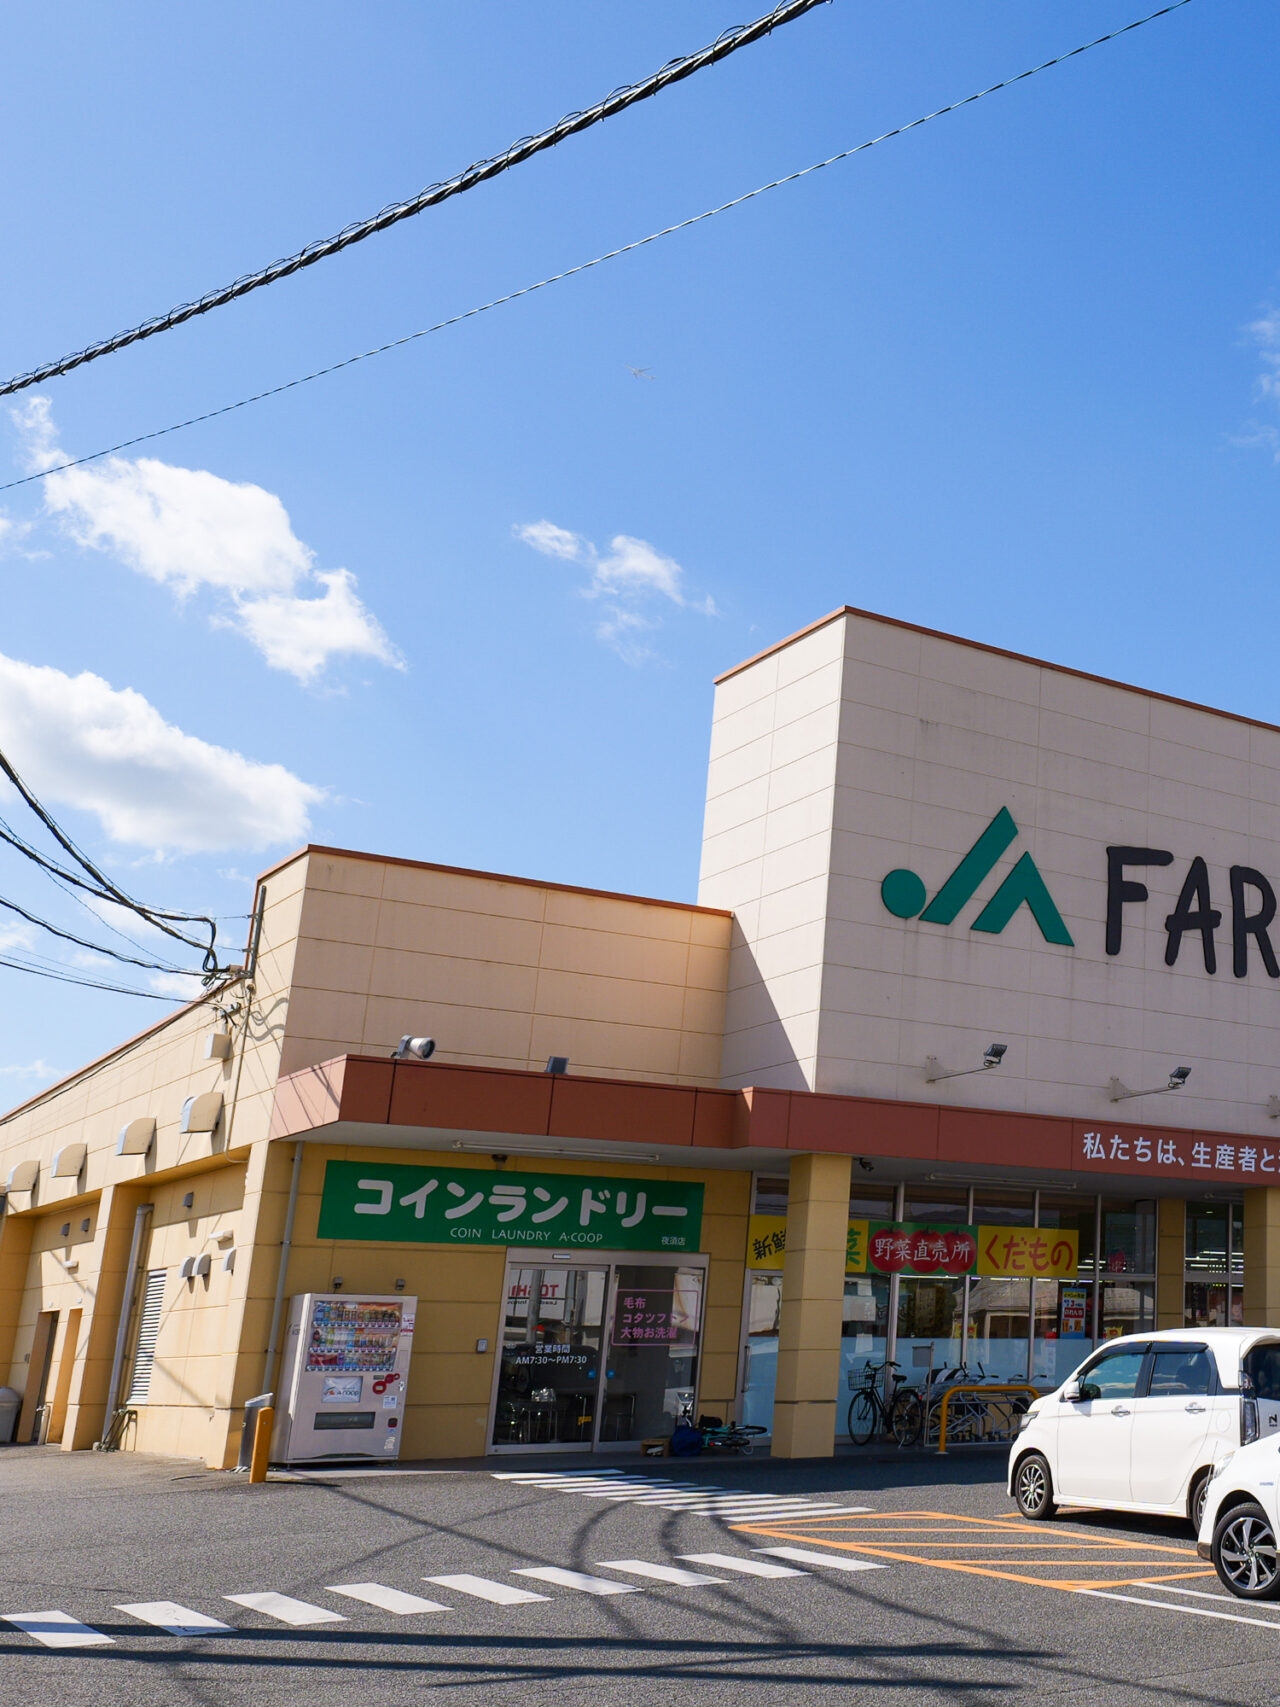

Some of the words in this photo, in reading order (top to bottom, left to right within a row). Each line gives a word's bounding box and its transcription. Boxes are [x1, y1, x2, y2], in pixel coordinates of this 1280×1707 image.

[353, 1178, 688, 1228] コインランドリー
[449, 1227, 482, 1239] COIN
[491, 1229, 551, 1241] LAUNDRY
[874, 1236, 972, 1264] 野菜直売所
[984, 1233, 1074, 1272] くだもの
[623, 1297, 646, 1309] 毛布
[622, 1312, 690, 1325] コタツフトン
[620, 1326, 678, 1339] 大物お洗濯
[535, 1344, 571, 1354] 営業時間
